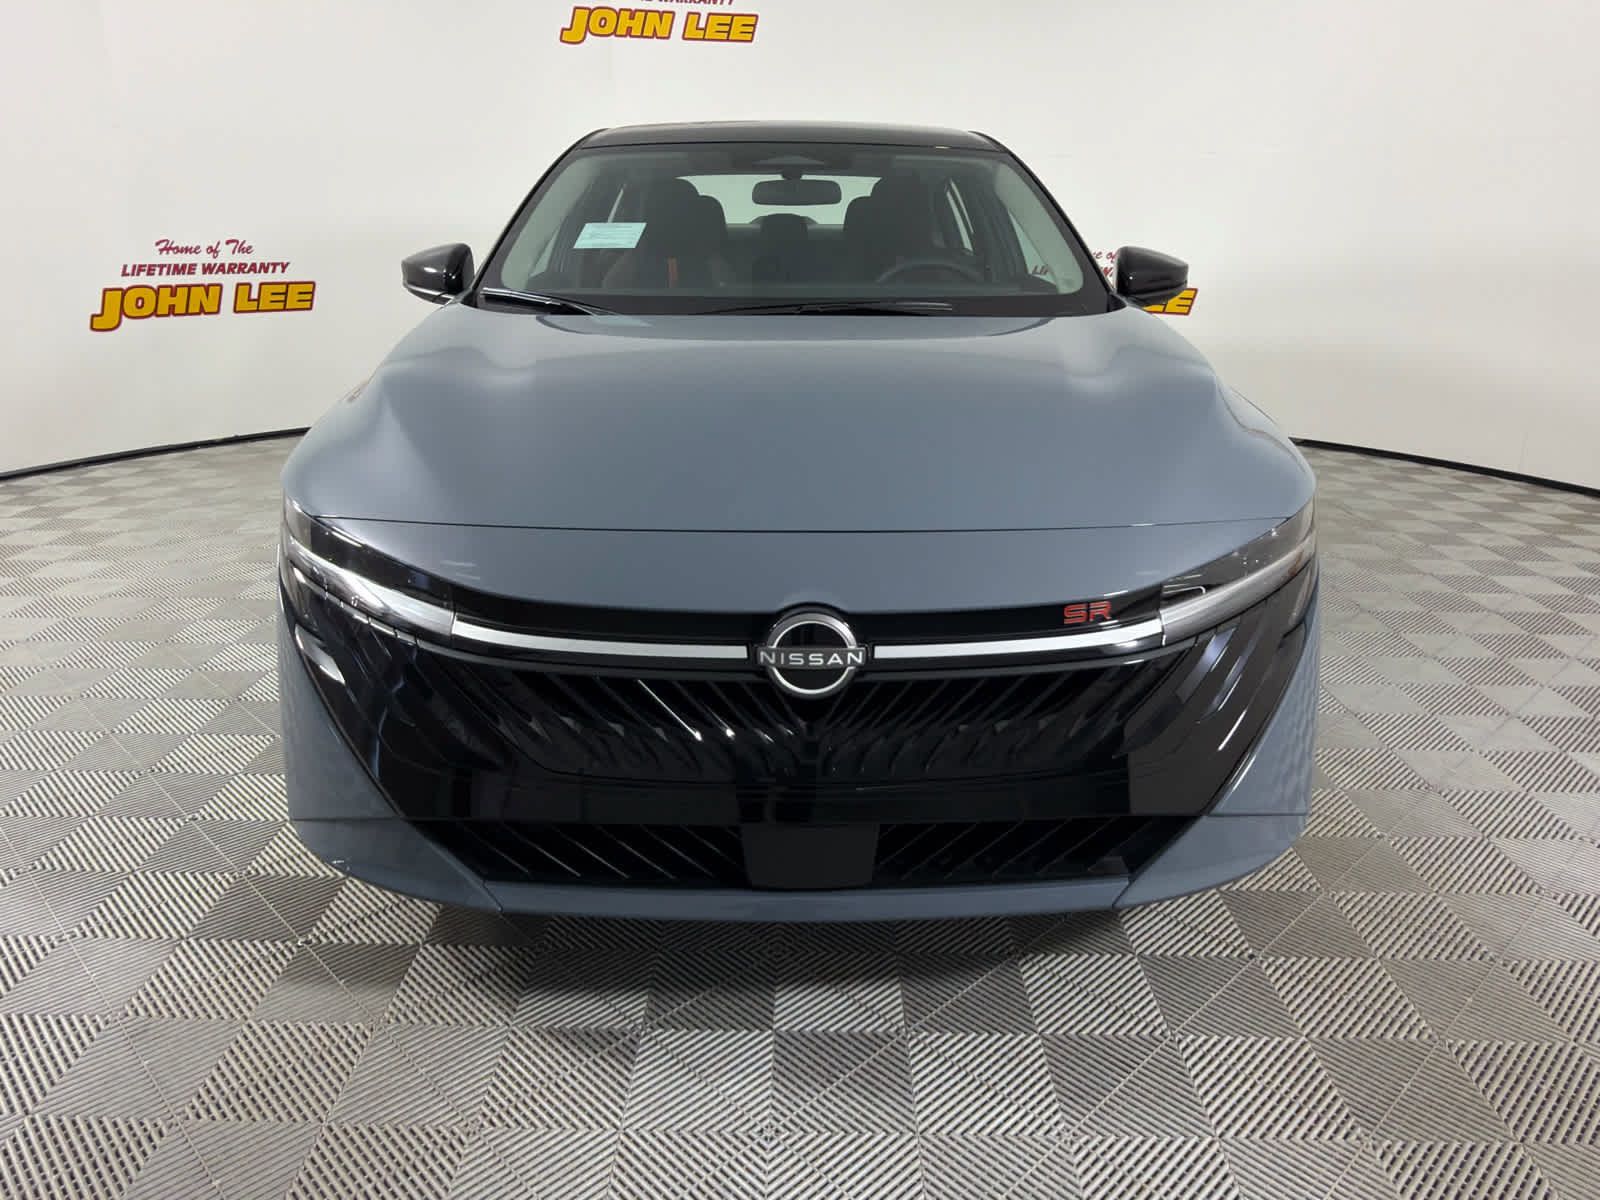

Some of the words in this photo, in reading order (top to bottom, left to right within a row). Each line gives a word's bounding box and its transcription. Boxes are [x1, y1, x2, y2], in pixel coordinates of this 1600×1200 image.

[559, 6, 675, 45] JOHN
[682, 12, 759, 43] LEE
[154, 238, 201, 255] Home
[206, 240, 221, 259] of
[225, 238, 254, 255] The
[120, 262, 197, 277] LIFETIME
[201, 261, 290, 275] WARRANTY
[90, 283, 223, 332] JOHN
[233, 281, 316, 313] LEE
[1063, 601, 1112, 624] SR
[760, 651, 863, 665] NISSAN
